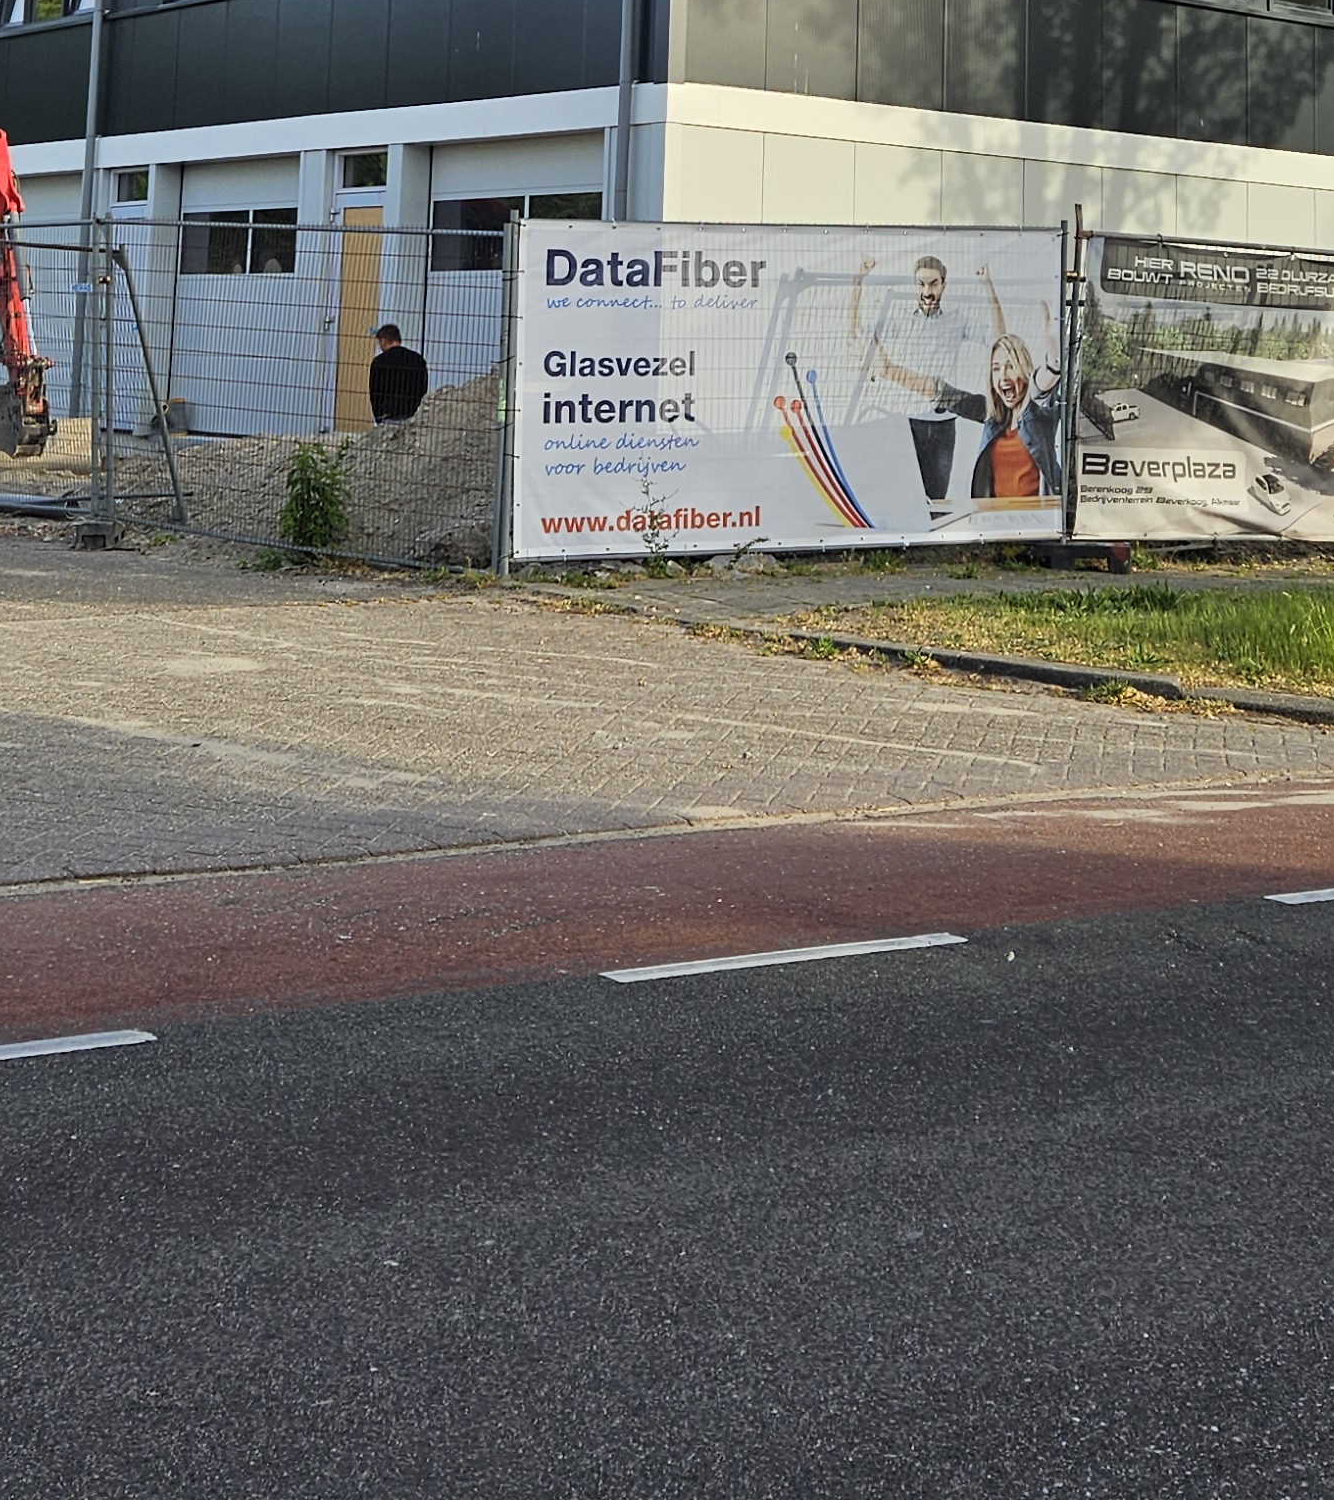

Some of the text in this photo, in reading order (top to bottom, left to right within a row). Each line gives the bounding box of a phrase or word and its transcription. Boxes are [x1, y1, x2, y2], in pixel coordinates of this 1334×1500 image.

[546, 249, 767, 288] DataFiber
[1134, 255, 1175, 271] HIER
[1179, 260, 1251, 284] RENO
[1256, 266, 1279, 280] 22
[1106, 268, 1174, 285] BOUWT
[1178, 279, 1252, 293] PROJECTEN
[547, 297, 571, 309] we
[672, 295, 687, 309] to
[694, 294, 759, 309] deliver
[543, 350, 696, 377] Glasvezel
[542, 392, 696, 424] internet
[544, 432, 700, 450] online diensten
[545, 456, 687, 478] voor bedrijven
[1081, 452, 1237, 483] Beverplaza
[1080, 485, 1134, 496] Berenkoog
[541, 506, 761, 534] www.datafiber.nl
